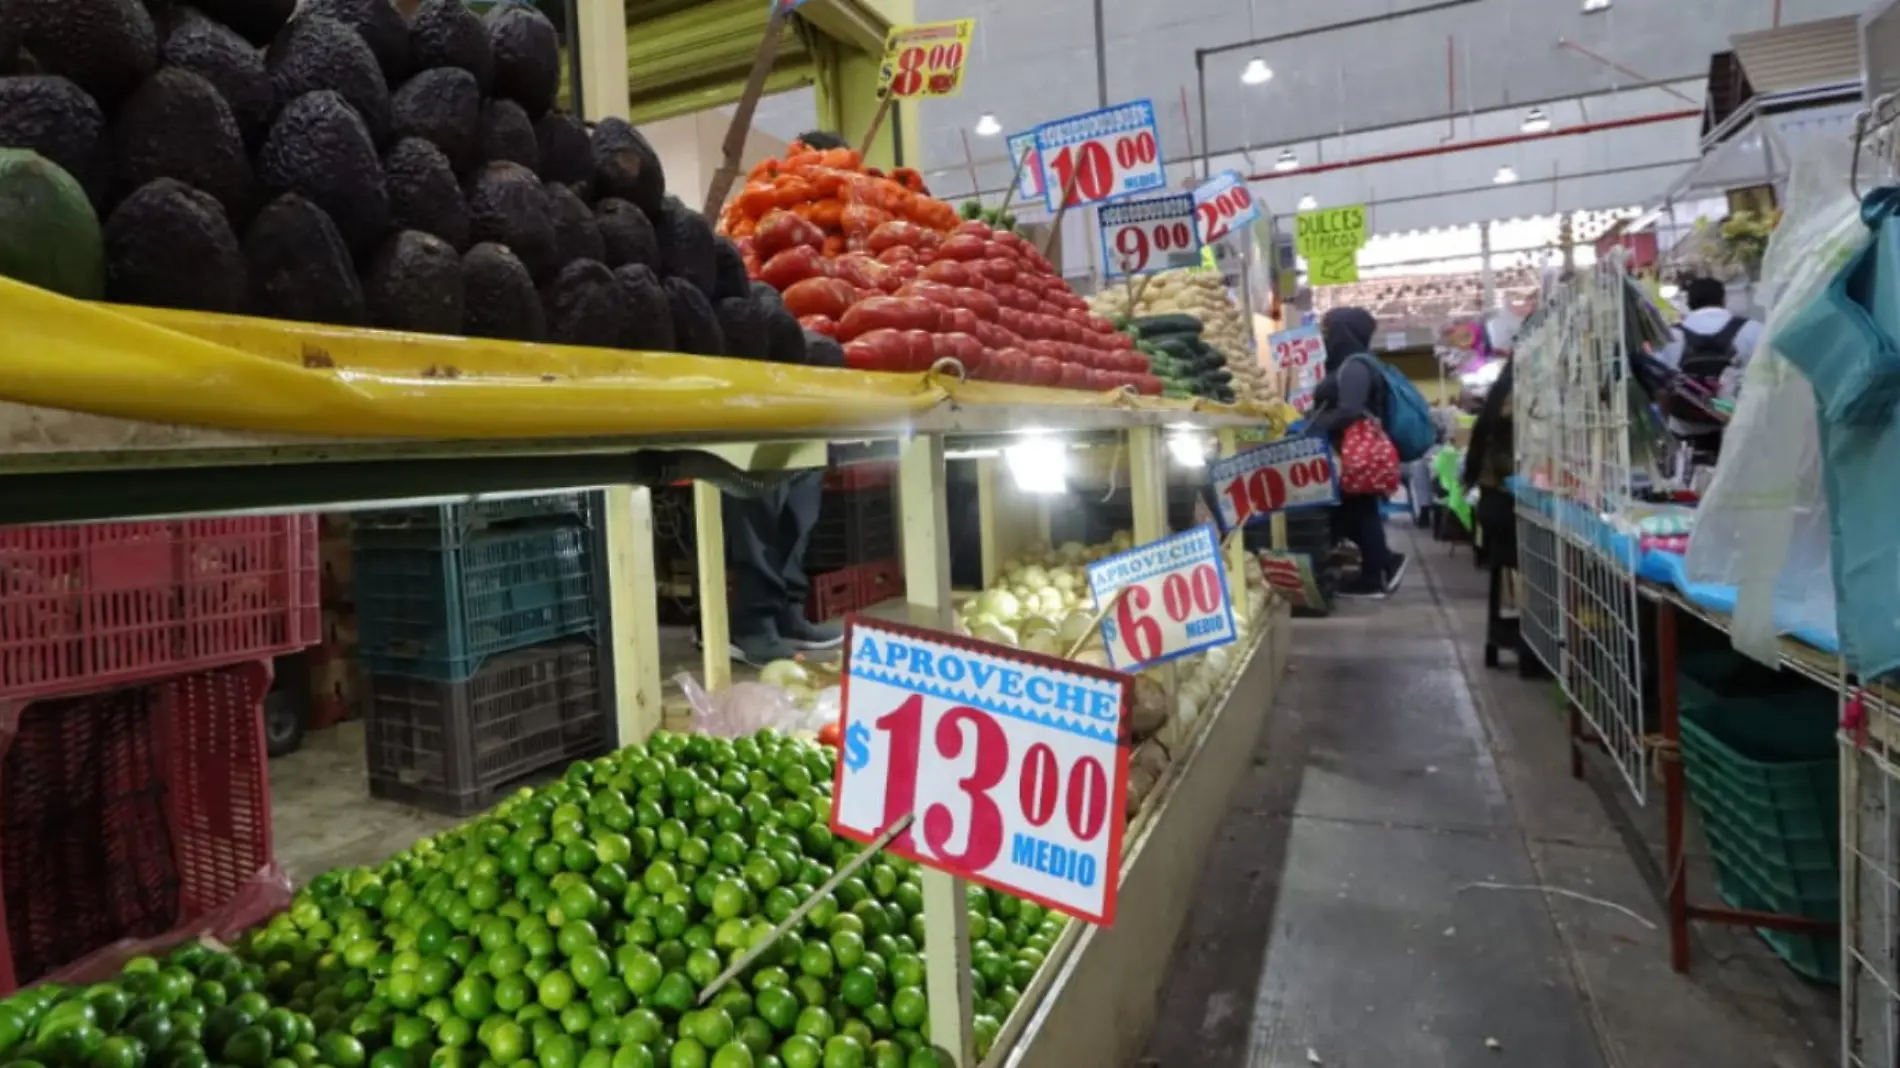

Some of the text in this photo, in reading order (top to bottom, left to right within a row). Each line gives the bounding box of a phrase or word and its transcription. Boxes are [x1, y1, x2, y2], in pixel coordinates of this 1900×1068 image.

[1297, 208, 1362, 236] DULCES
[1096, 536, 1208, 585] APROVECHE
[854, 636, 1118, 723] APROVECHE
[1011, 832, 1097, 888] MEDIO
